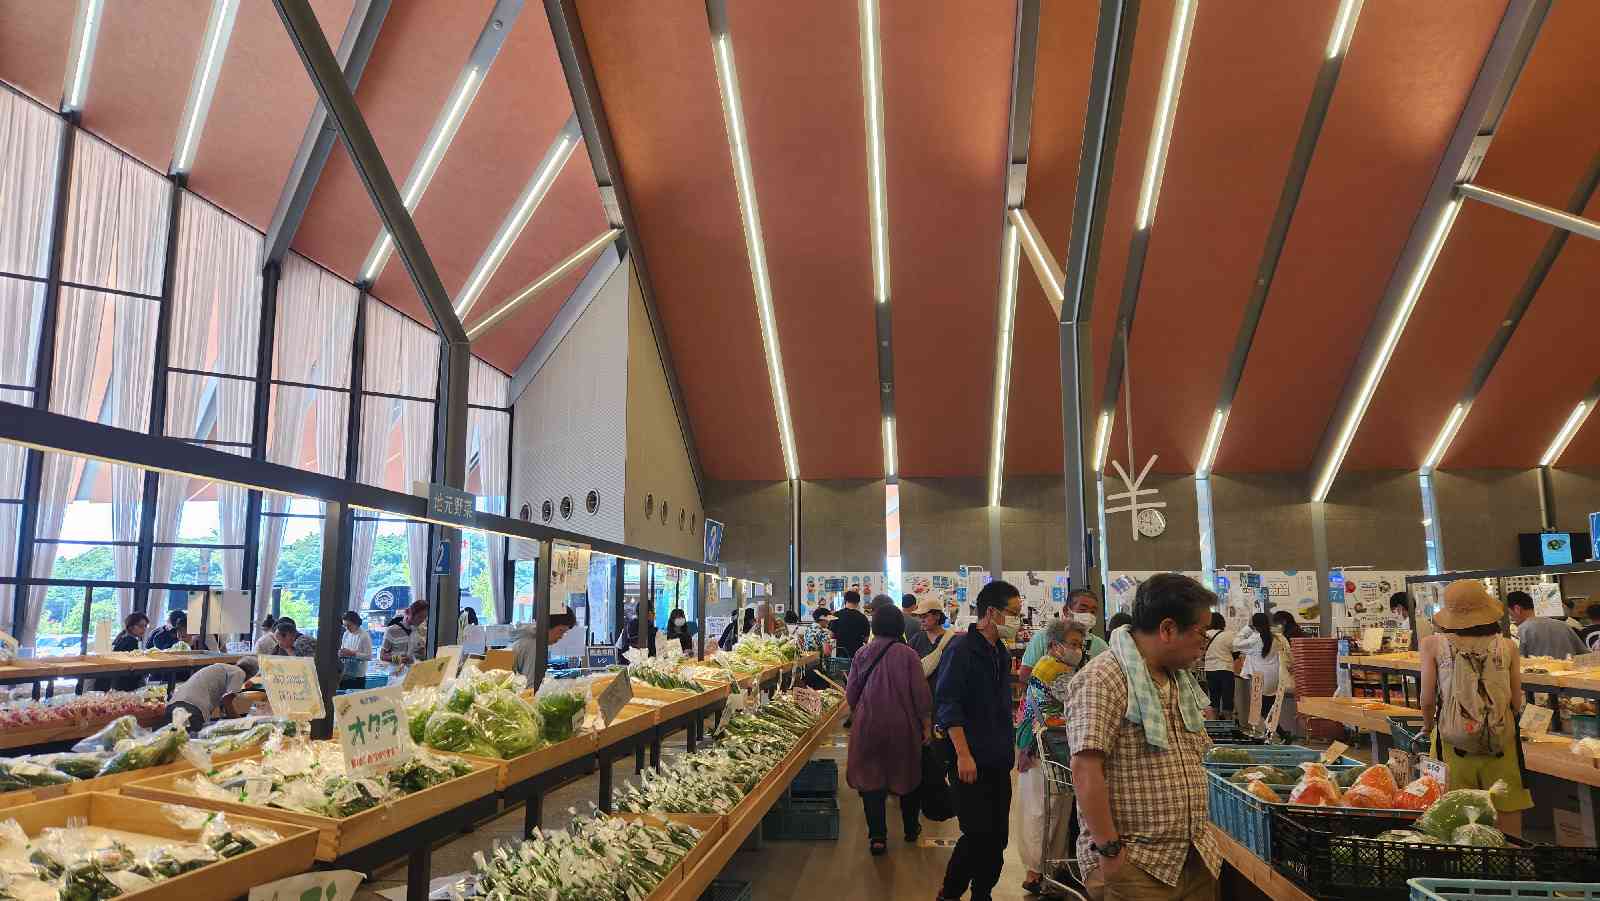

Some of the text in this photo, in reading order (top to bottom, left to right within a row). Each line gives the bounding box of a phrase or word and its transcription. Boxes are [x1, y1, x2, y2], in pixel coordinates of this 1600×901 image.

[434, 494, 473, 519] 地元野菜
[435, 542, 444, 572] 2
[348, 708, 399, 746] オクラ
